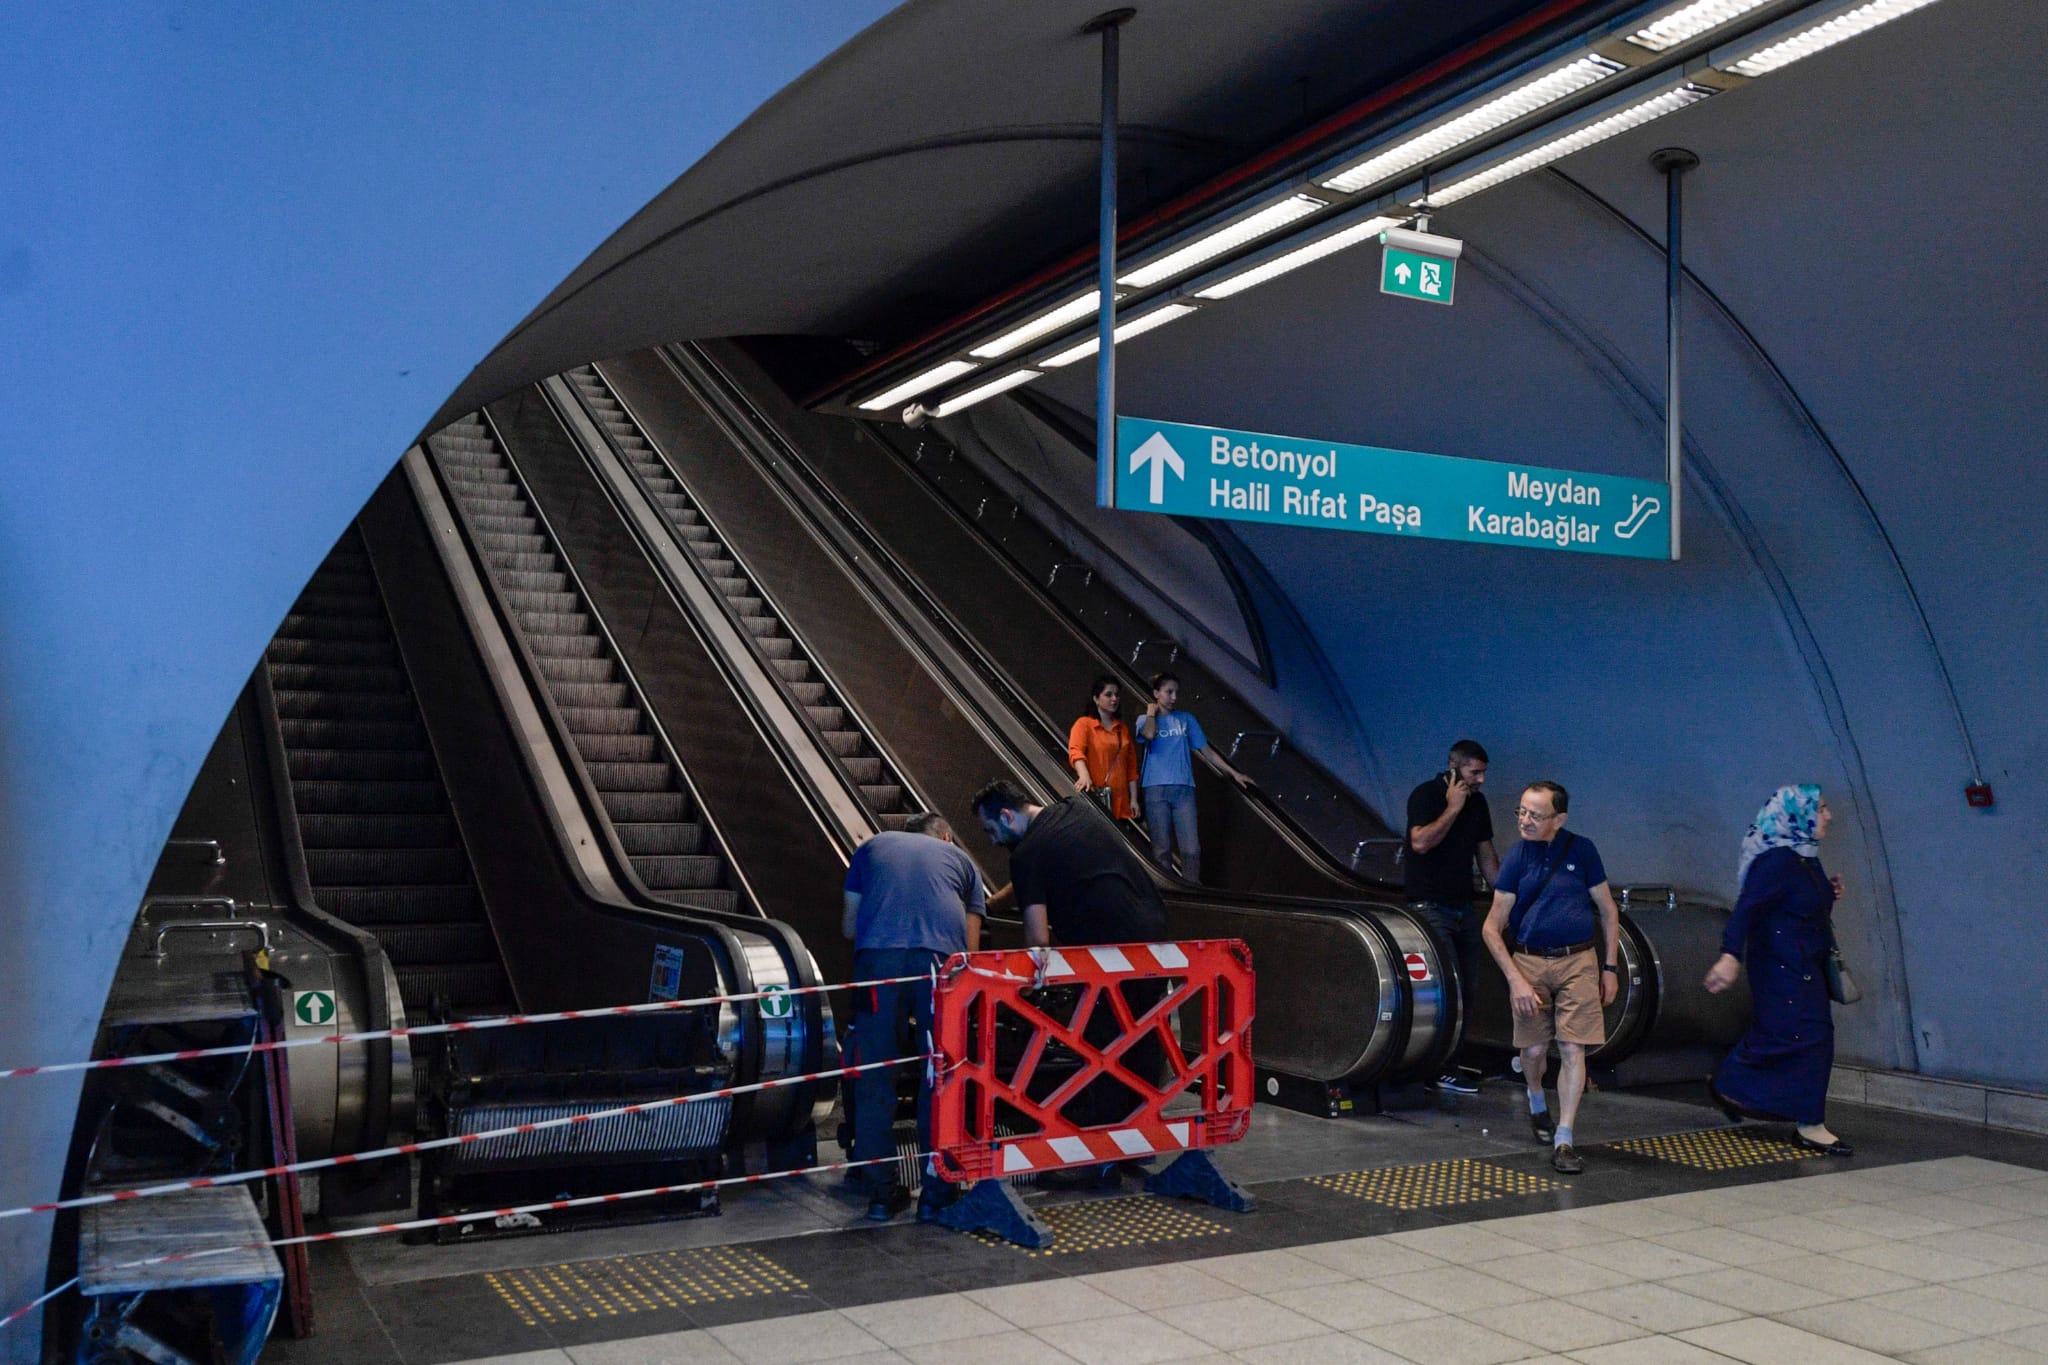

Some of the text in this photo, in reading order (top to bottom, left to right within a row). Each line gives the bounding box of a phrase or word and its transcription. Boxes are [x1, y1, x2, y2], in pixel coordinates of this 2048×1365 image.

[1211, 435, 1336, 480] Betonyol
[1210, 478, 1421, 531] Halil Rıfat Paşa
[1508, 471, 1601, 507] Meydan
[1468, 505, 1600, 547] Karabağlar
